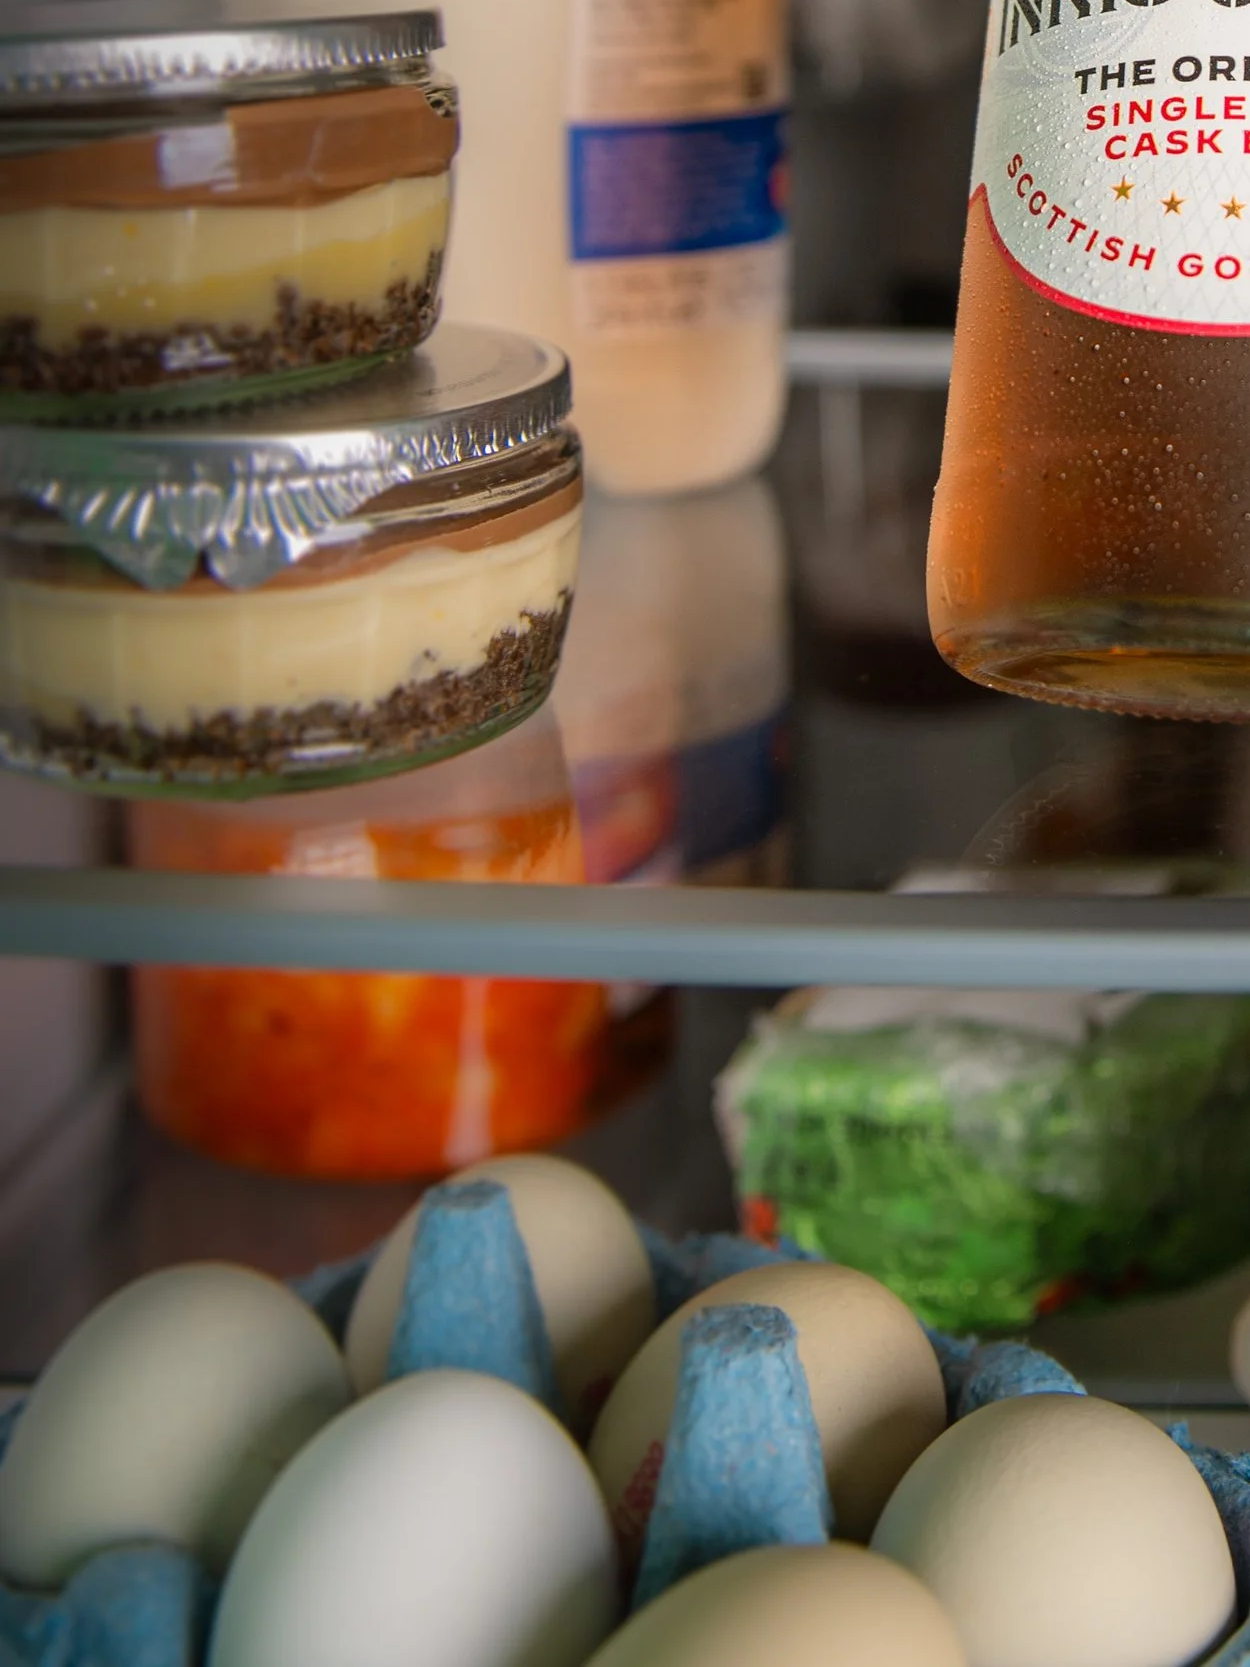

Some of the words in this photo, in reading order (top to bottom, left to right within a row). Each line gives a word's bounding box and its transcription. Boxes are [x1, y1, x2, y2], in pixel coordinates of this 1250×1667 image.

[1074, 59, 1156, 95] THE
[1086, 96, 1247, 132] SINGLE
[1104, 129, 1223, 161] CASK
[1006, 153, 1156, 271] SCOTTISH
